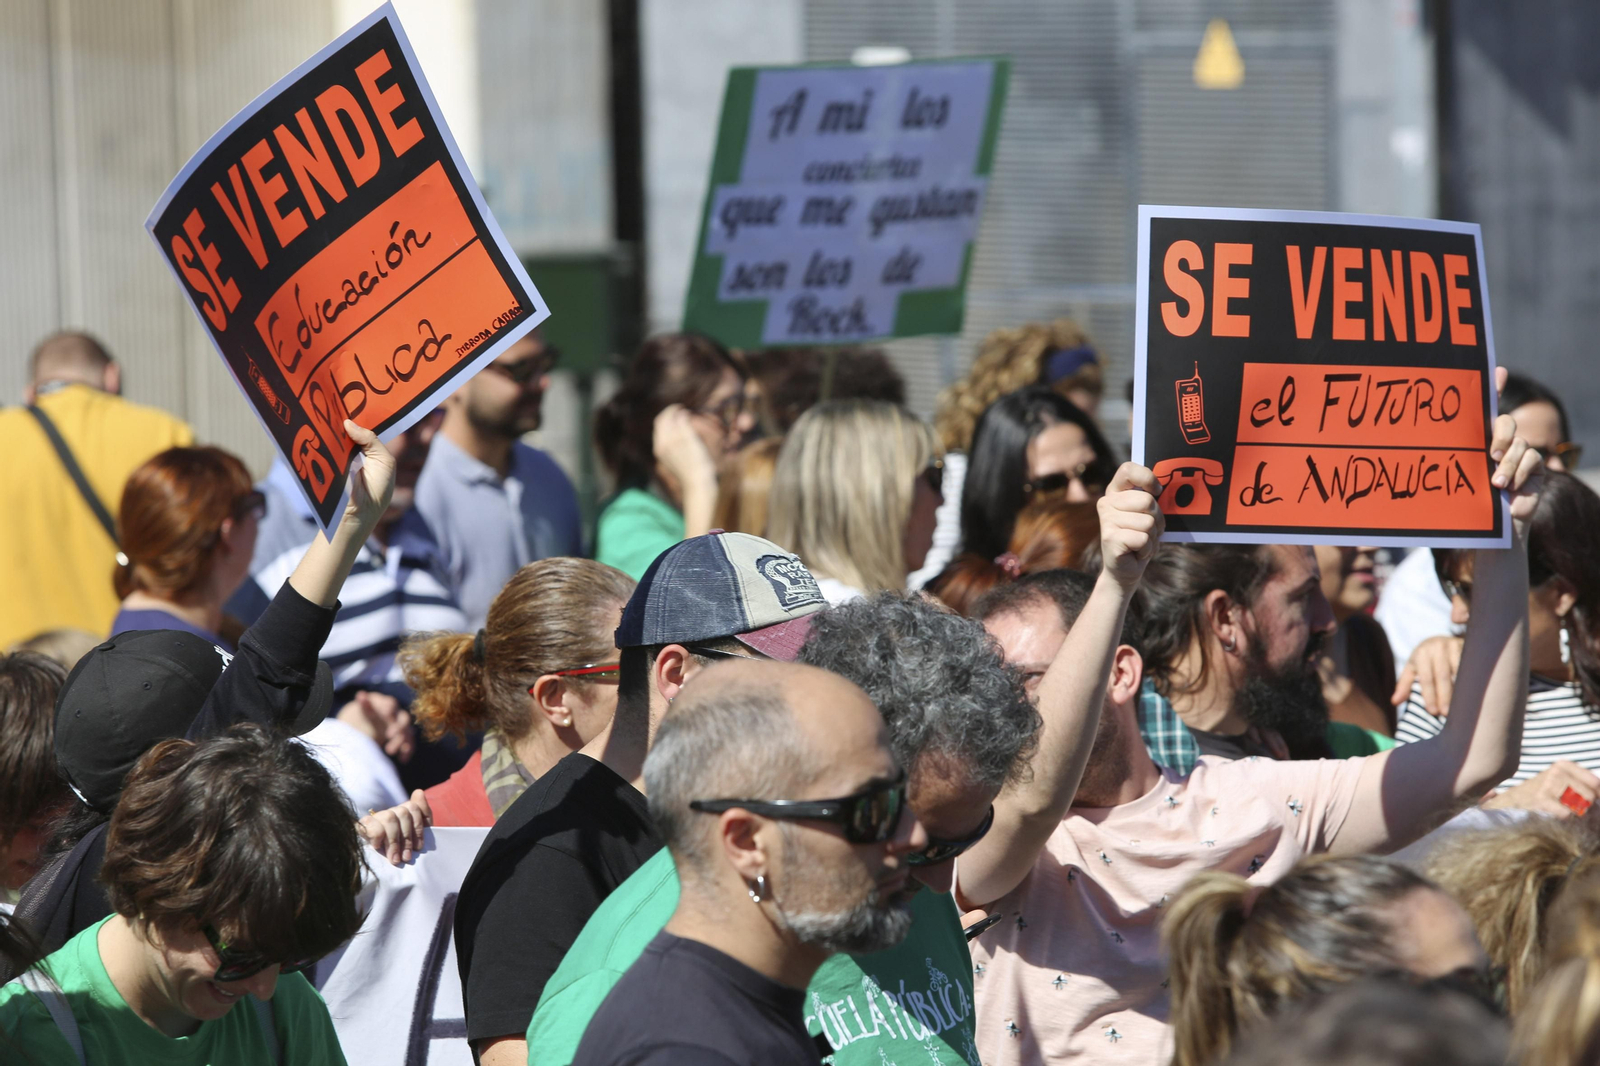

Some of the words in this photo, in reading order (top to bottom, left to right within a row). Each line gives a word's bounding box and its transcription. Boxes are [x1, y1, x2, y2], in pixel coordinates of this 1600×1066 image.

[901, 85, 951, 131] los
[172, 208, 242, 332] SE
[210, 49, 425, 270] VENDE
[720, 193, 785, 240] que
[801, 194, 854, 226] me
[868, 186, 979, 240] gustan
[727, 260, 789, 292] son
[803, 249, 853, 289] los
[880, 246, 923, 286] de
[1160, 239, 1254, 338] SE
[1285, 244, 1478, 346] VENDE
[1250, 375, 1296, 428] el
[1318, 373, 1461, 433] FUTURO
[1239, 461, 1284, 507] de
[1298, 454, 1475, 509] ANDALUCÍA
